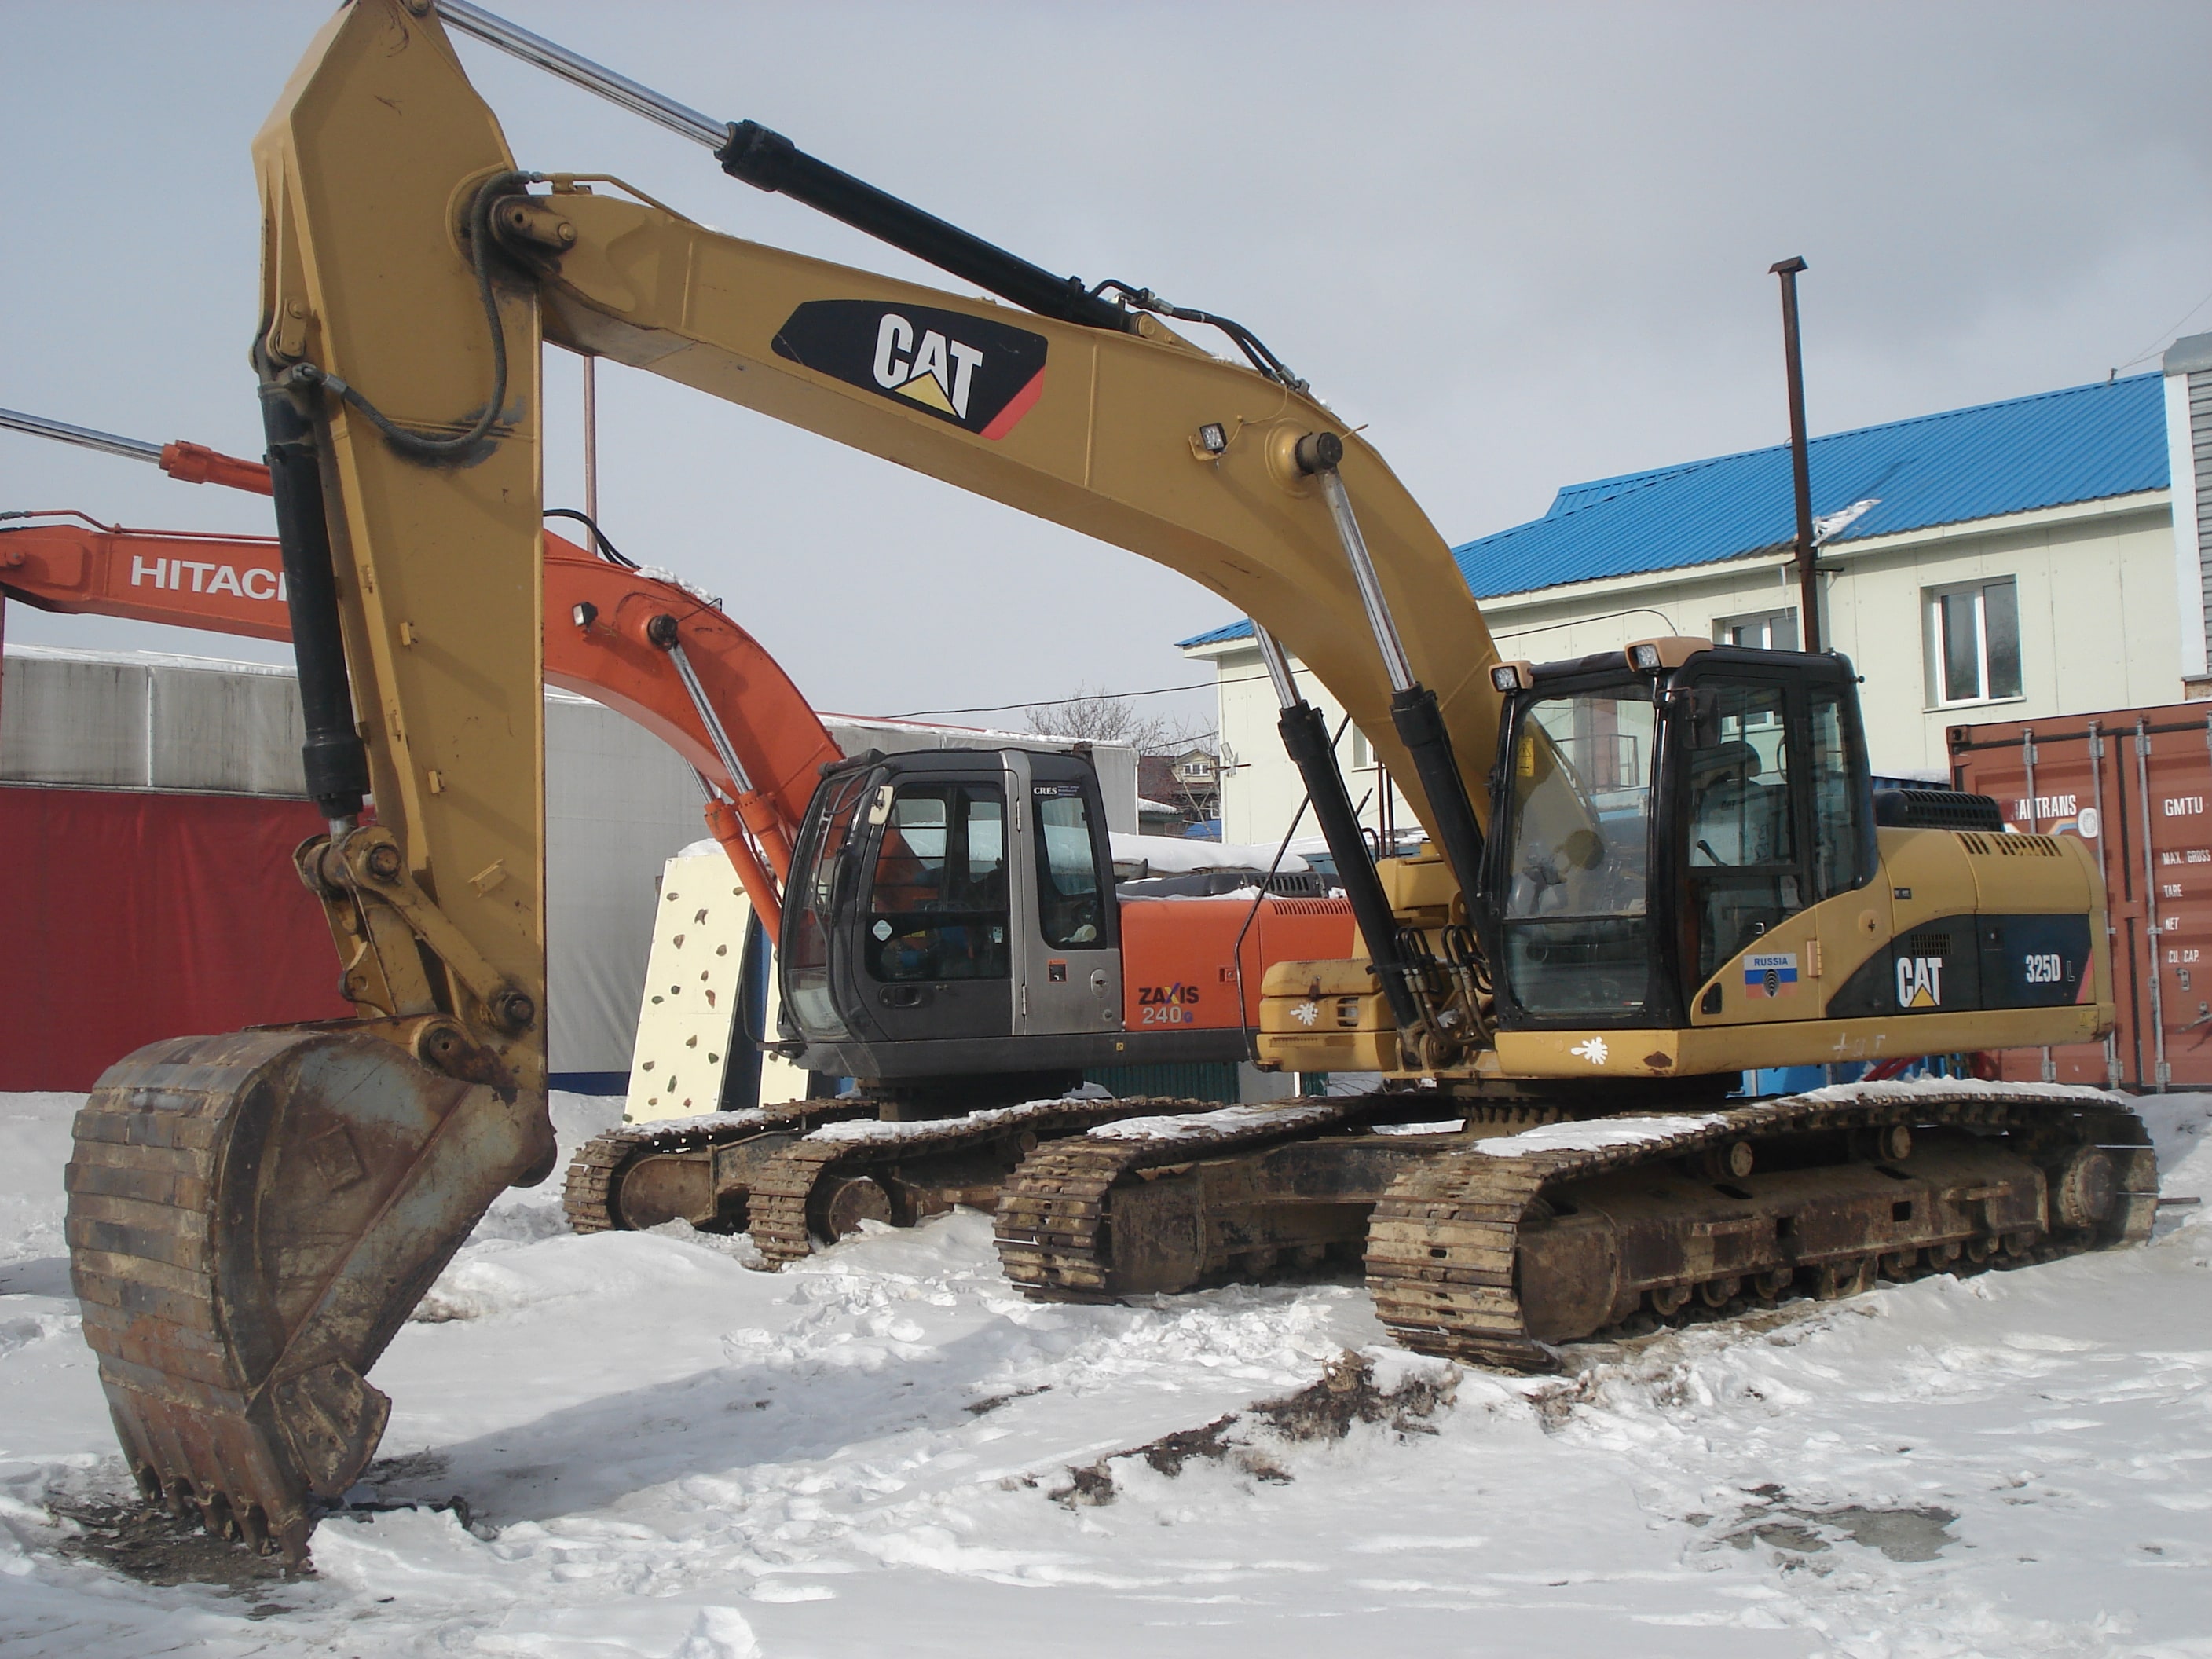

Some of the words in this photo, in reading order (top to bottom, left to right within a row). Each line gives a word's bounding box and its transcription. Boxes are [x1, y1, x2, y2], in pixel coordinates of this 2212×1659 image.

[873, 313, 984, 420] CAT
[130, 555, 288, 602] HITAC
[1033, 786, 1057, 795] CRES
[2164, 796, 2203, 816] GMTU
[2186, 849, 2211, 863] GROSS
[2163, 884, 2183, 898] TARE
[2165, 917, 2180, 931] NET
[1754, 957, 1788, 966] RUSSIA
[2025, 954, 2062, 983] 325D
[1896, 956, 1943, 1008] CAT
[1138, 982, 1199, 1005] ZAXIS
